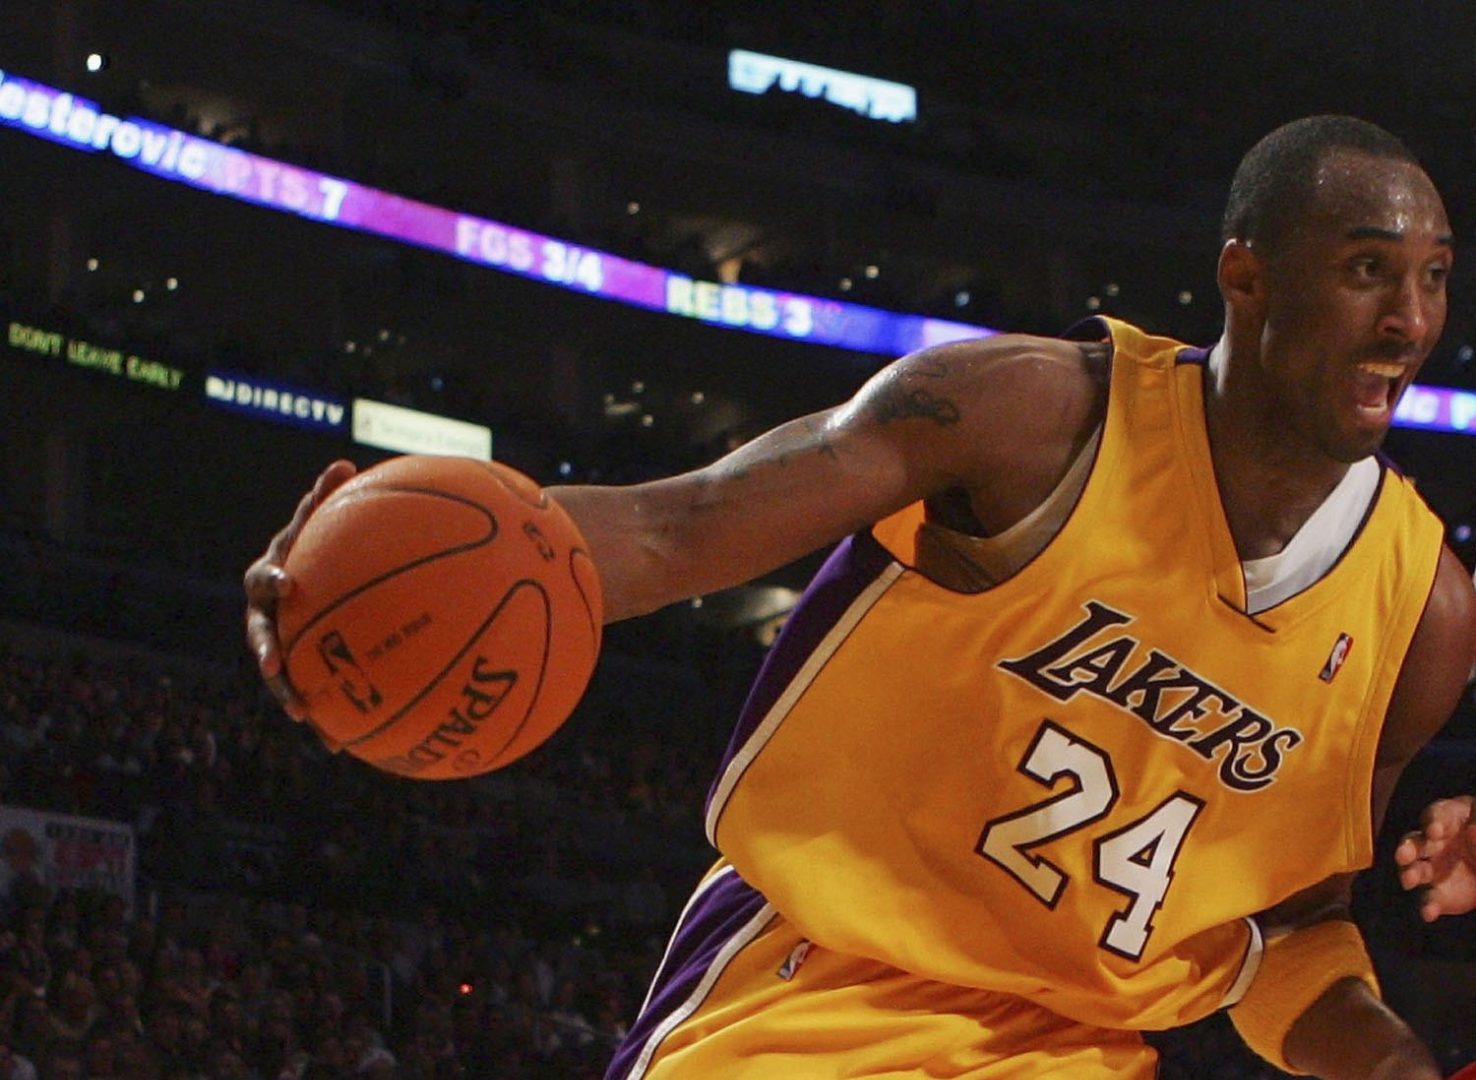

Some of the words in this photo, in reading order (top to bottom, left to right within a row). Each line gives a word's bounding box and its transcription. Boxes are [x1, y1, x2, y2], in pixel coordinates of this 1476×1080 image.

[0, 68, 209, 179] esterovic
[319, 176, 347, 221] 7
[456, 215, 536, 272] FGS
[542, 239, 604, 293] 3/4
[666, 272, 779, 331] REBS
[783, 297, 813, 338] 3
[236, 381, 344, 425] DIRECTV
[996, 599, 1304, 795] LAKERS
[974, 717, 1206, 963] 24
